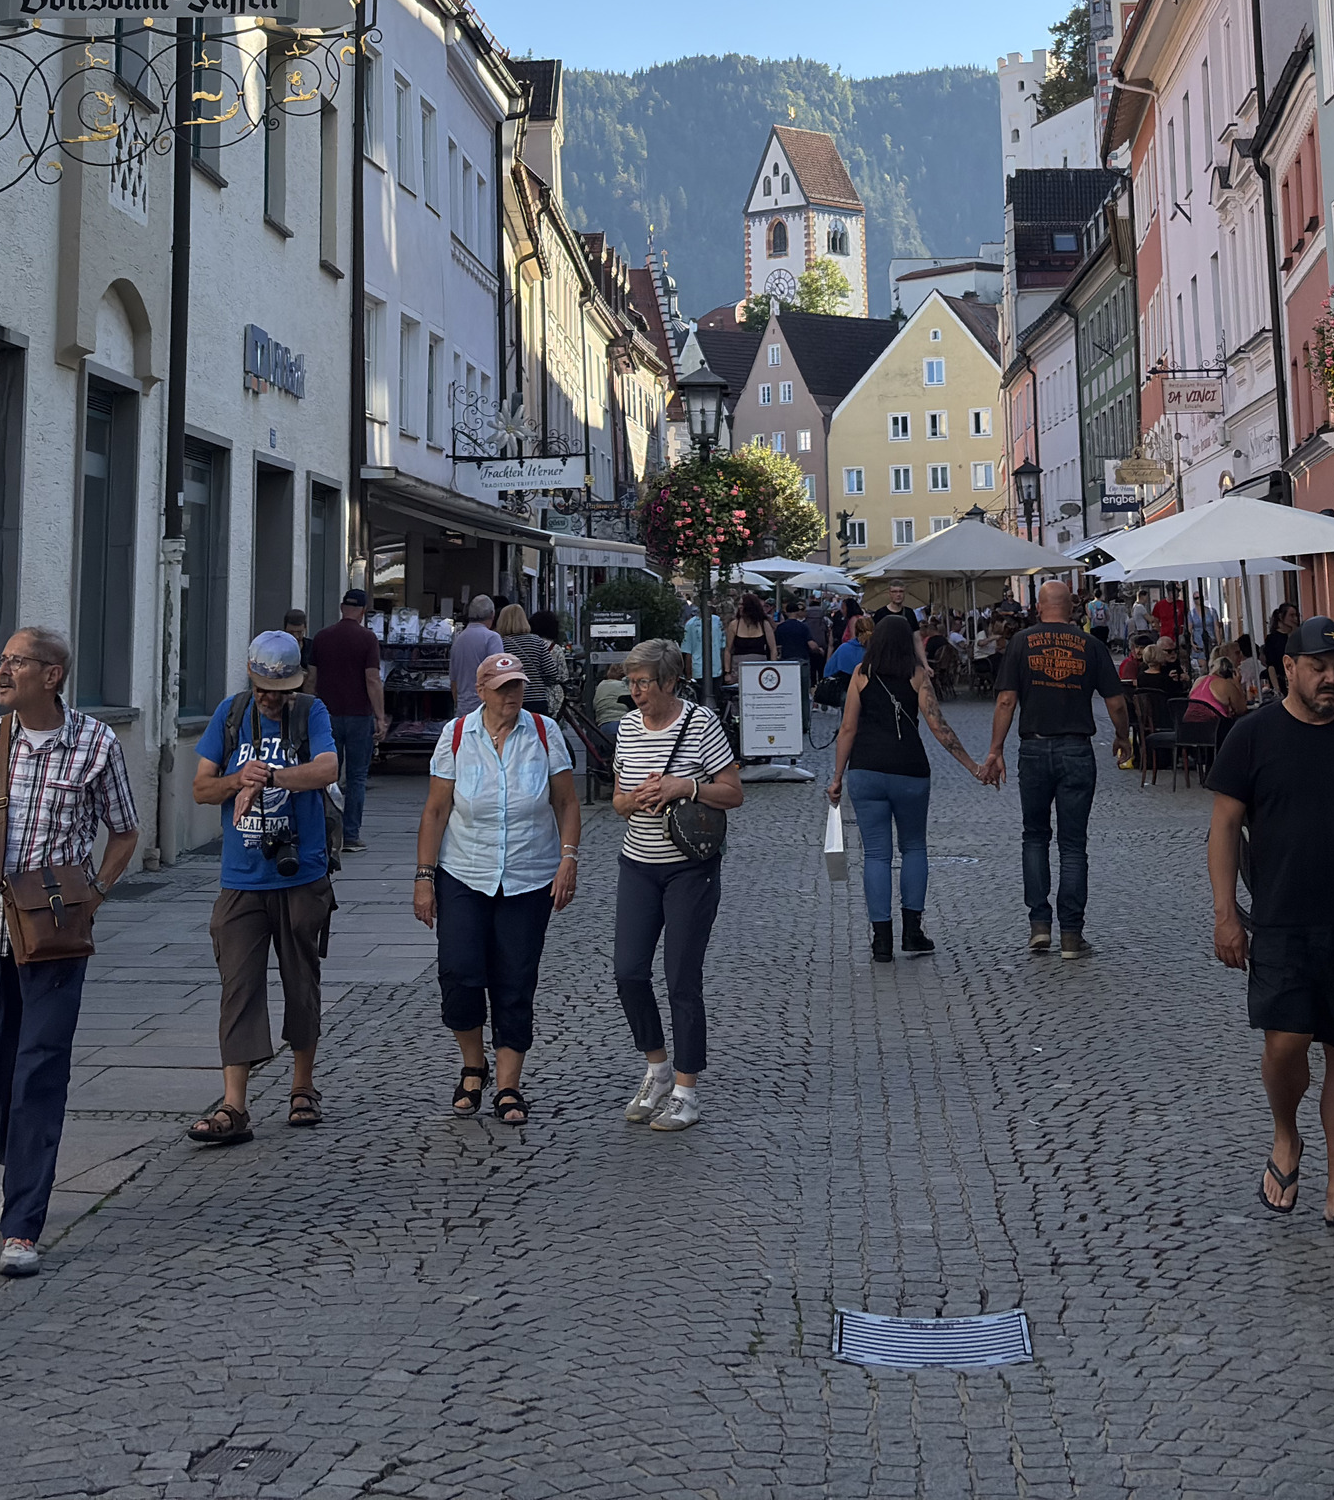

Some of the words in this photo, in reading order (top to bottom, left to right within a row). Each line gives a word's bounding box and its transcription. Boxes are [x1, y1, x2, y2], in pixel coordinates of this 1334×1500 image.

[1167, 390, 1182, 405] DA
[1186, 387, 1218, 403] VINCI
[480, 464, 524, 480] Trachten
[527, 464, 564, 478] Werner
